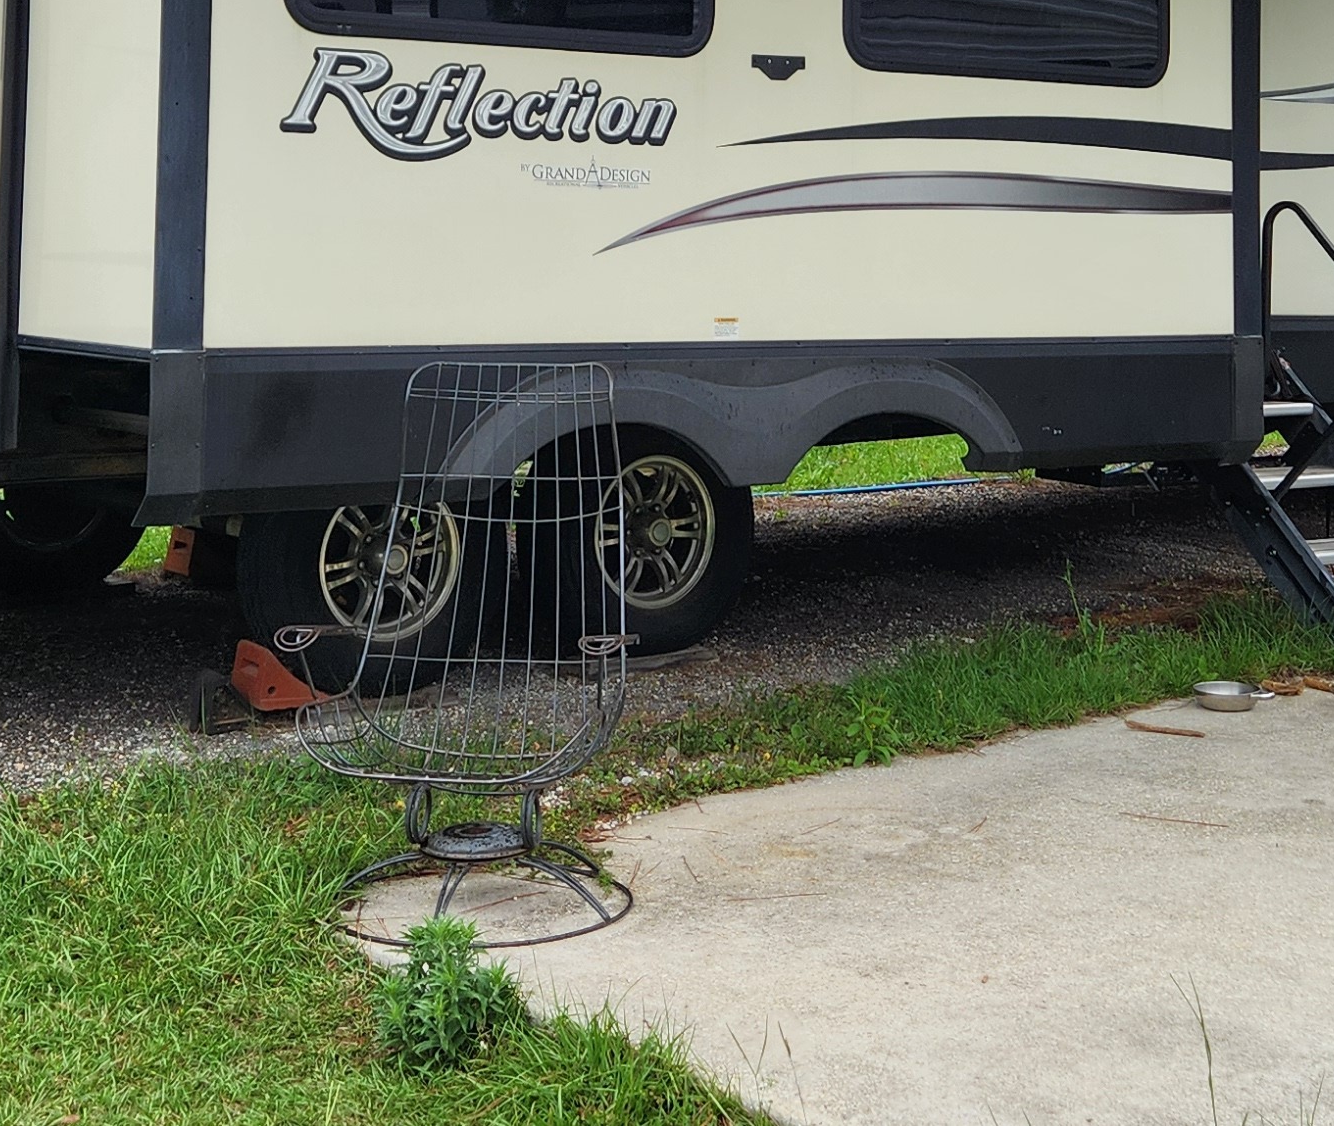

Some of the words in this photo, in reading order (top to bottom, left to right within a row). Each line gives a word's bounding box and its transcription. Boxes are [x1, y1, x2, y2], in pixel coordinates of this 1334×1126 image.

[280, 47, 677, 162] Reflection
[520, 163, 531, 172] BY
[532, 164, 587, 180] GRAND
[600, 166, 651, 182] DESIGN
